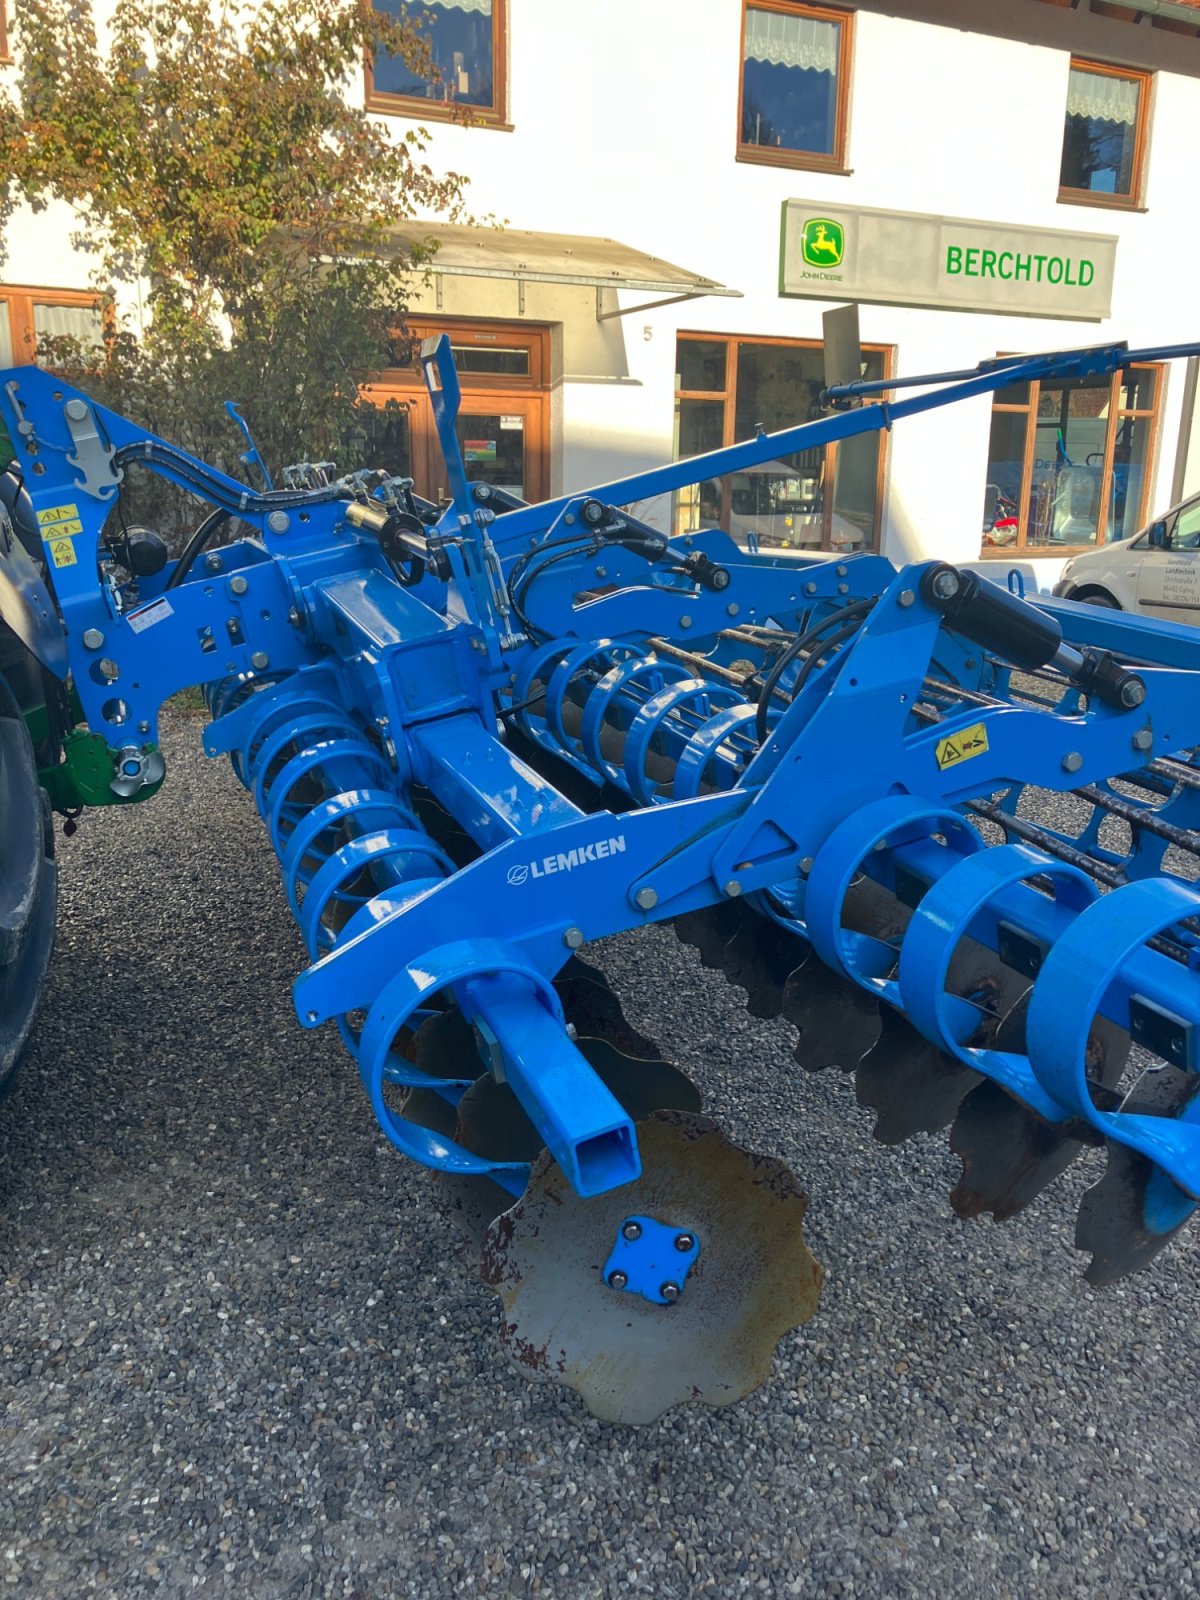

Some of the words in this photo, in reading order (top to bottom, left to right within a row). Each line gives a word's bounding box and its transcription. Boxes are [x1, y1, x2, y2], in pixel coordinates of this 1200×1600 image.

[800, 270, 820, 280] JOHN
[820, 272, 844, 282] DEERE
[946, 246, 1095, 287] BERCHTOLD
[643, 325, 653, 341] 5
[530, 835, 626, 879] LEMKEN
